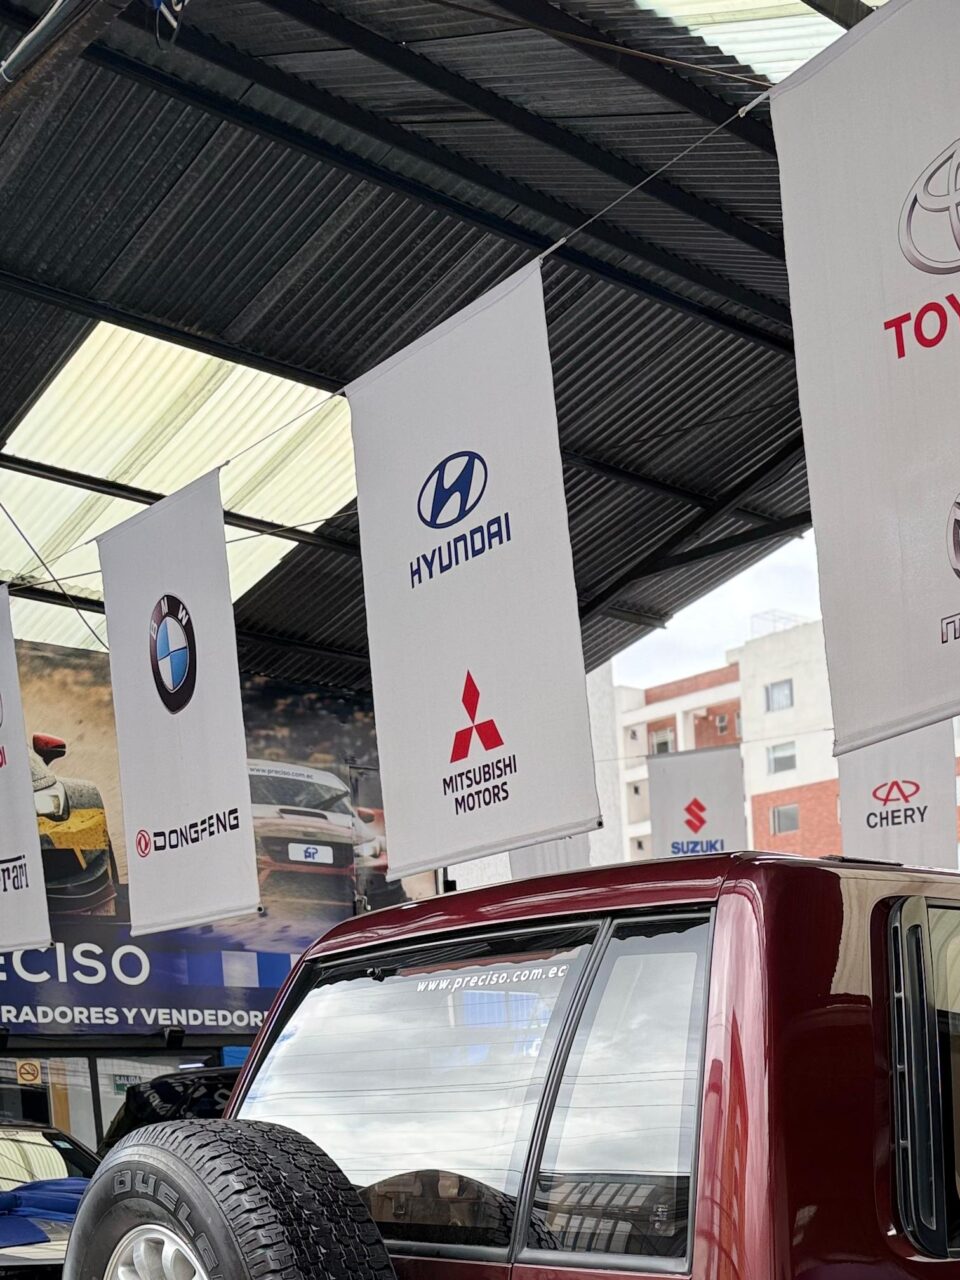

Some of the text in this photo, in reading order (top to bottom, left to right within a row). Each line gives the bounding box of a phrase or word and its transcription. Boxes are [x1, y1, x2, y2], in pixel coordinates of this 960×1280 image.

[409, 512, 512, 589] HYUNDAI
[442, 753, 518, 797] MITSUBISHI
[454, 780, 510, 816] MOTORS
[152, 807, 240, 852] DONGFENG
[865, 805, 929, 829] CHERY
[671, 839, 725, 855] SUZUKI
[0, 856, 30, 892] rari
[0, 942, 151, 986] CISO
[416, 963, 570, 993] www.preciso.com.ec
[122, 1008, 139, 1025] Y
